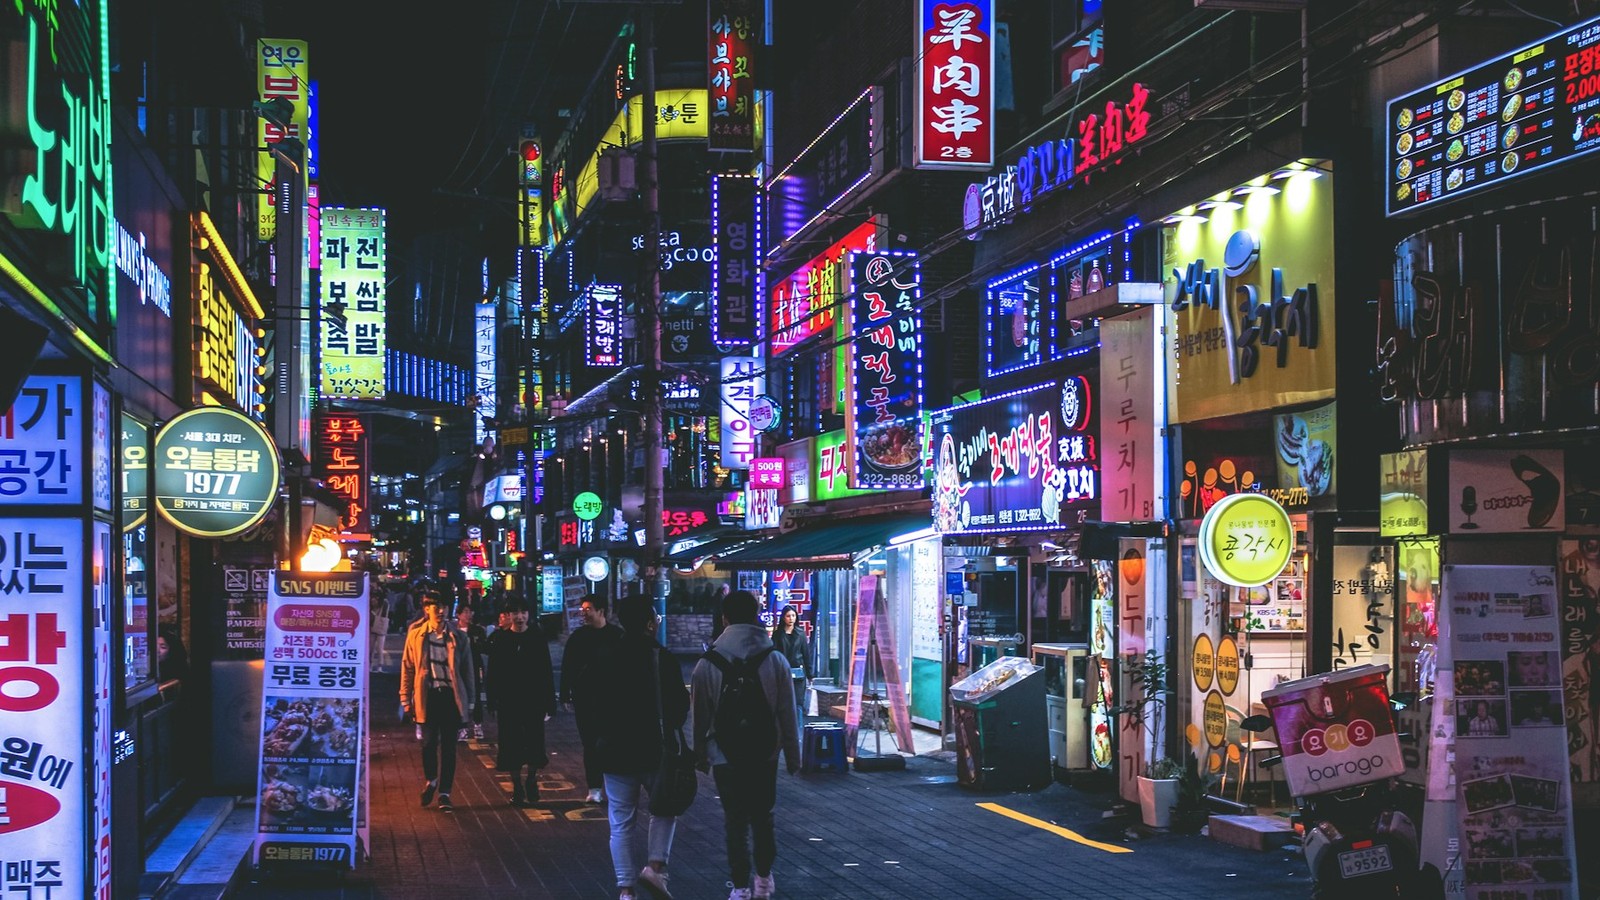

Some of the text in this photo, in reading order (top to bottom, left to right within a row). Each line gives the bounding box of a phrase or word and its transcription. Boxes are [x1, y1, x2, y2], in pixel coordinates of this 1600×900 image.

[262, 46, 304, 68] 연우
[712, 14, 732, 119] 샤브샤브
[734, 17, 753, 119] 양꼬치
[928, 10, 986, 140] 羊肉串
[940, 148, 973, 162] 2층
[1017, 138, 1074, 213] 양꼬치
[325, 213, 382, 229] 민속주점
[326, 237, 381, 269] 파전
[724, 222, 754, 325] 영화관
[328, 281, 382, 312] 보쌈
[327, 322, 383, 356] 족발
[860, 292, 897, 426] 조개전골
[184, 432, 242, 444] 서울 3대 치킨
[326, 418, 365, 442] 블루
[1116, 355, 1139, 518] 두루치기
[165, 446, 261, 473] 오늘통닭
[988, 411, 1057, 487] 조개전골
[757, 462, 783, 471] 500원
[863, 473, 919, 486] 322-8682
[184, 471, 242, 496] 1977
[326, 447, 362, 528] 노래방
[1054, 466, 1095, 502] 양꼬치
[573, 501, 603, 514] 노래방
[1222, 532, 1284, 562] 콩각시
[281, 580, 358, 596] SNS 이벤트
[292, 608, 342, 619] 자신의 SNS에
[273, 647, 358, 661] 생맥 500cc 1잔
[283, 635, 350, 649] 치즈볼 5개 or
[271, 664, 357, 688] 무료 증정
[1309, 729, 1369, 755] 요기요
[1307, 752, 1384, 782] barogo
[1354, 856, 1388, 872] 9592
